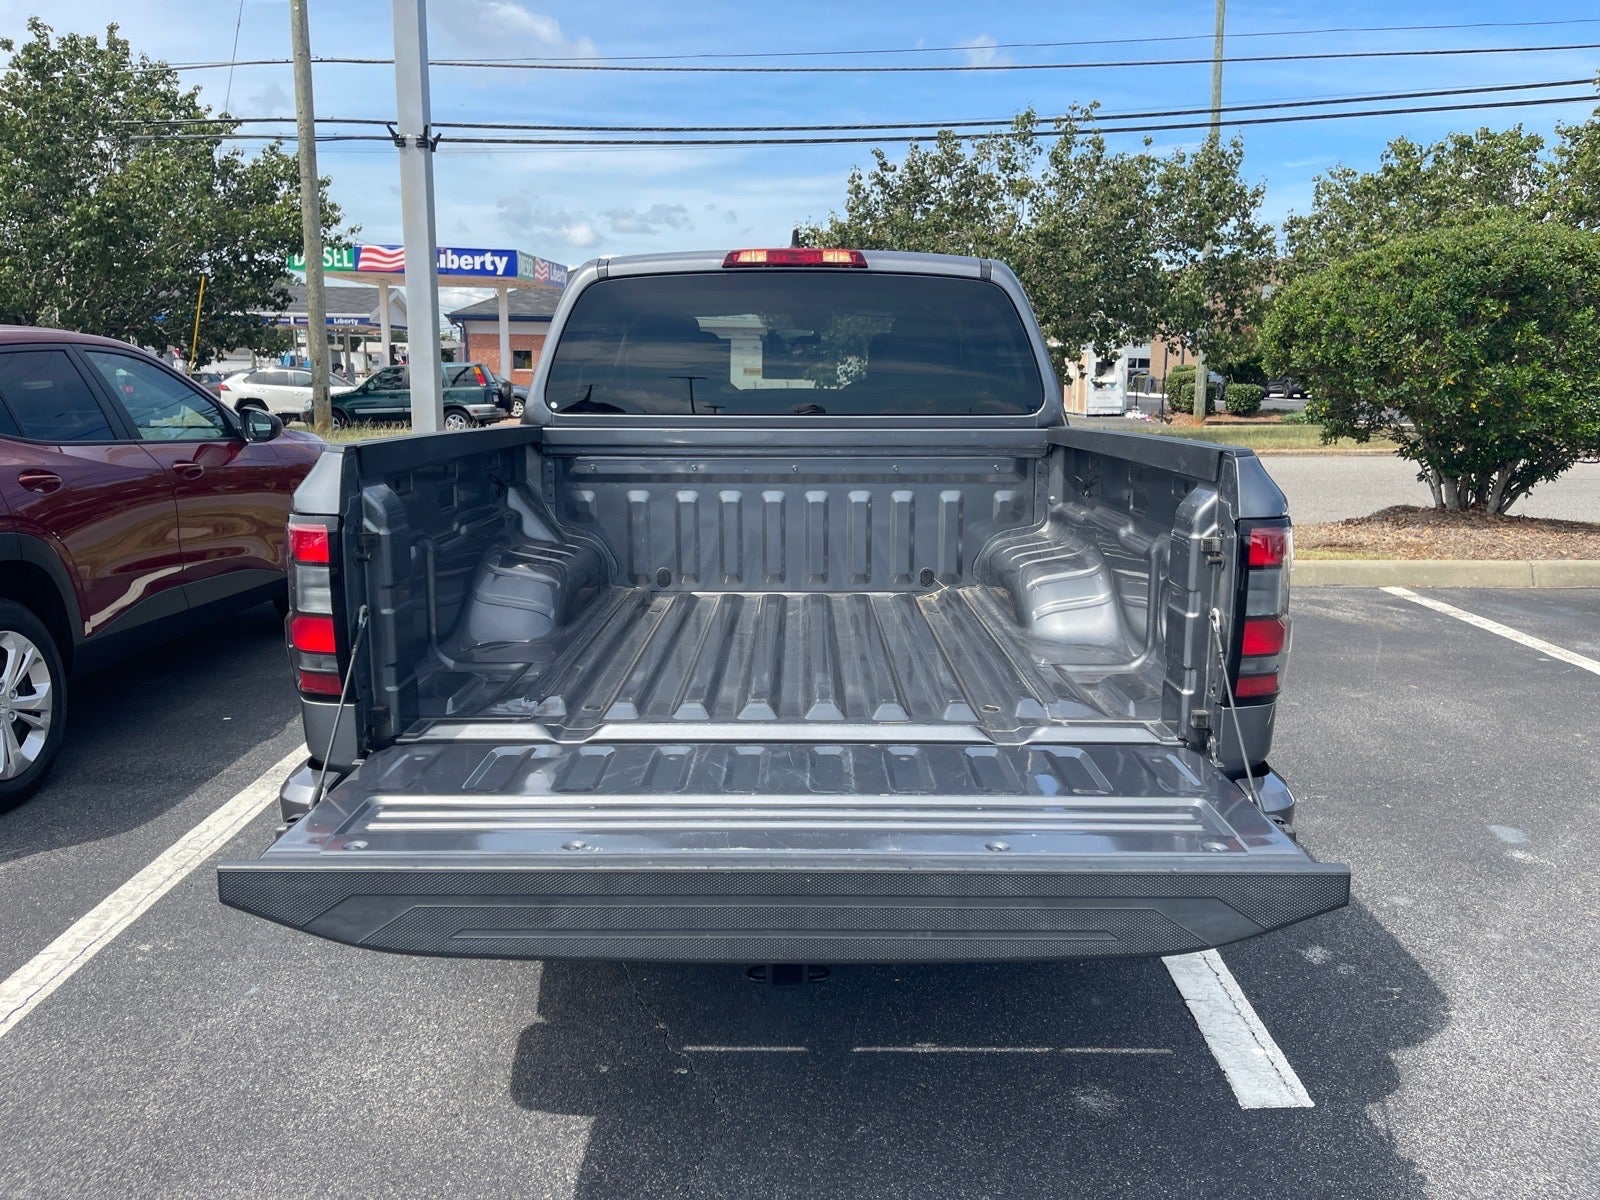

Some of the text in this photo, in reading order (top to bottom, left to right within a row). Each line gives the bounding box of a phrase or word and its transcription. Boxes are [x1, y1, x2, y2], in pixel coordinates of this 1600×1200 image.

[294, 246, 353, 267] DSEL
[437, 248, 508, 275] iberty
[520, 254, 534, 278] DIESEL
[550, 262, 567, 287] Liberty
